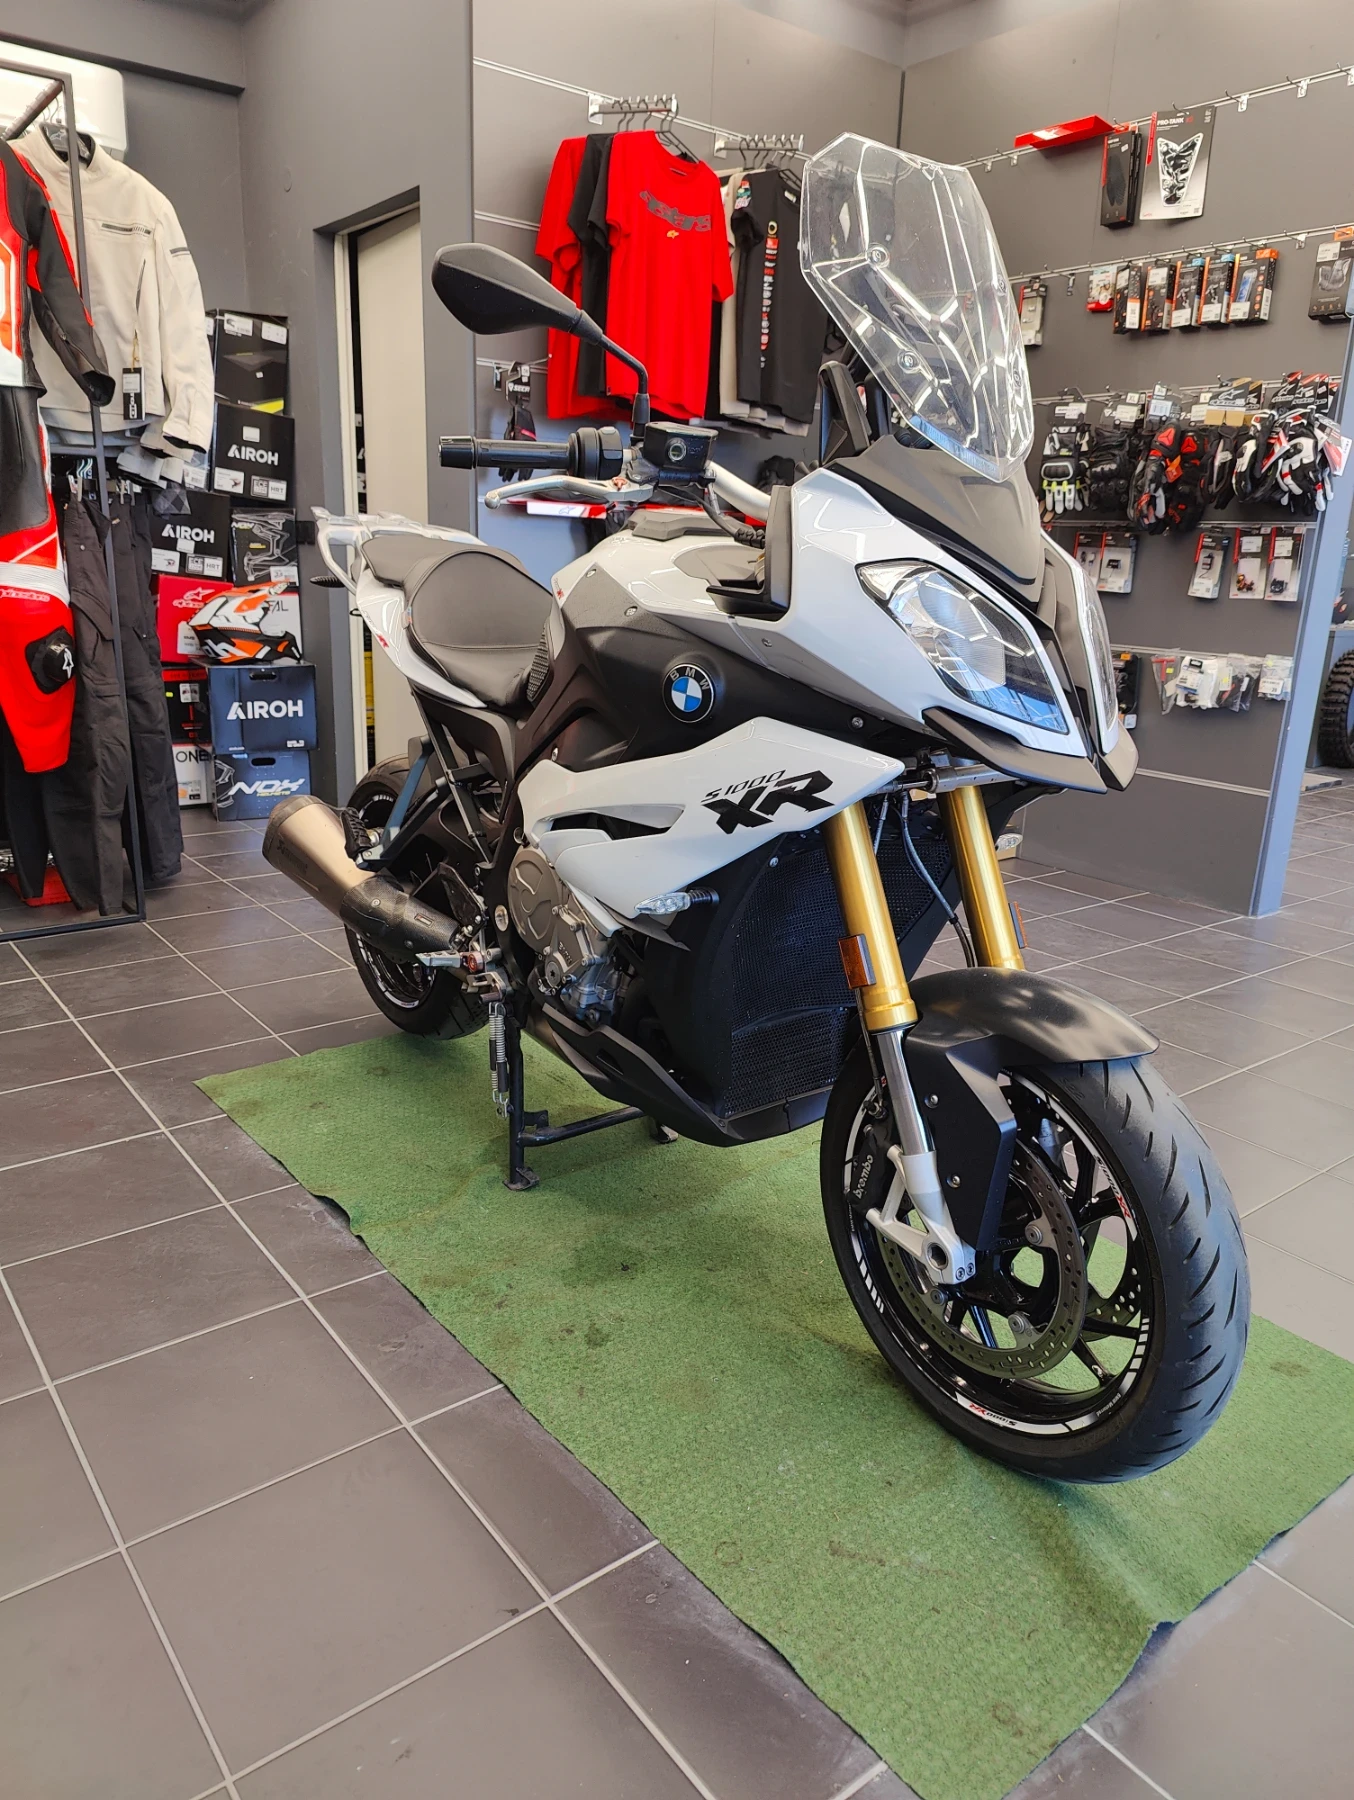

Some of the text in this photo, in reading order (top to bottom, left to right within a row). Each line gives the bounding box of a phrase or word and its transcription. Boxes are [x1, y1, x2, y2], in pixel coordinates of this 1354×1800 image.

[1157, 117, 1185, 126] PRO-TANK
[227, 444, 279, 466] AIROH
[270, 486, 284, 494] HRT
[161, 523, 215, 544] AIROH
[670, 666, 711, 691] BMW
[226, 699, 304, 721] AIROH
[228, 778, 306, 796] NOX
[701, 770, 835, 835] XR
[852, 1154, 874, 1199] brembo
